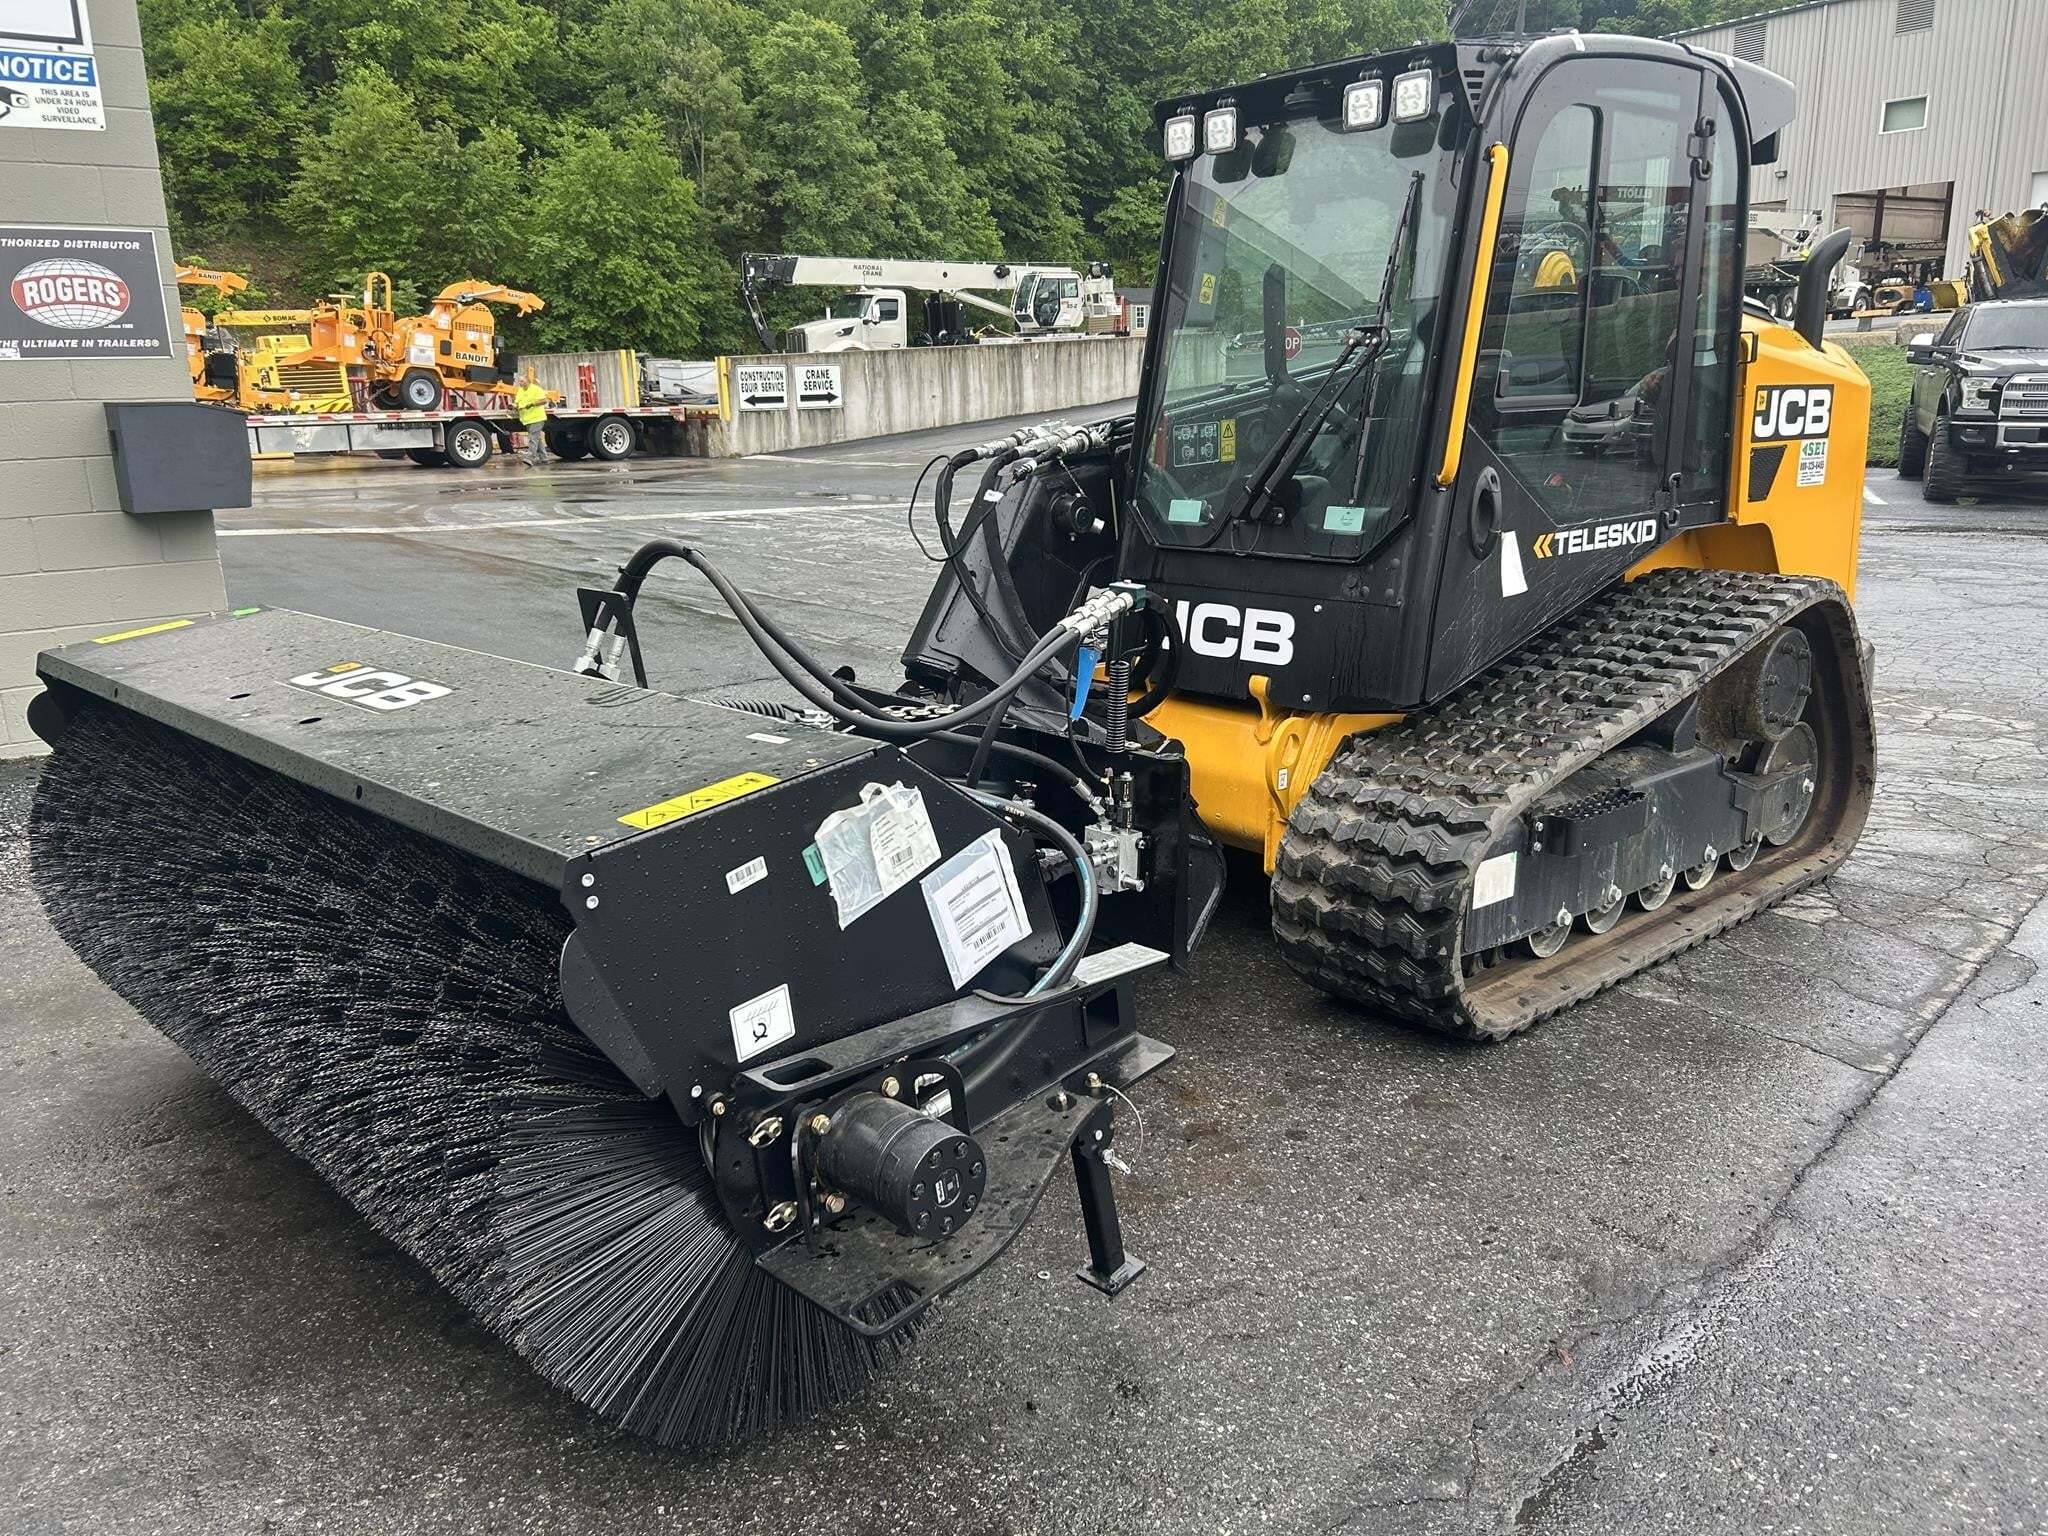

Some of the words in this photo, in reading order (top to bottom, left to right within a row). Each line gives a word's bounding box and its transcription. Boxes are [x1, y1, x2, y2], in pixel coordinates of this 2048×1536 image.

[40, 88, 58, 96] THIS
[60, 89, 80, 97] AREA
[34, 97, 62, 105] UNDER
[63, 98, 74, 106] 24
[75, 99, 98, 107] HOUR
[56, 106, 80, 115] VIDEO
[41, 114, 98, 124] SURVEILLANCE
[63, 239, 140, 250] DISTRIBUTOR
[22, 276, 121, 307] ROGERS
[22, 339, 78, 347] ULTIMATE
[81, 339, 94, 347] IN
[455, 352, 489, 363] BANDIT
[740, 371, 784, 381] CONSTRUCTION
[805, 369, 830, 380] CRANE
[761, 382, 785, 392] SERVICE
[803, 380, 834, 391] SERVICE
[1754, 389, 1832, 438] JCB
[1807, 441, 1826, 457] SEI
[1554, 519, 1657, 556] TELESKID
[290, 666, 453, 710] JCB
